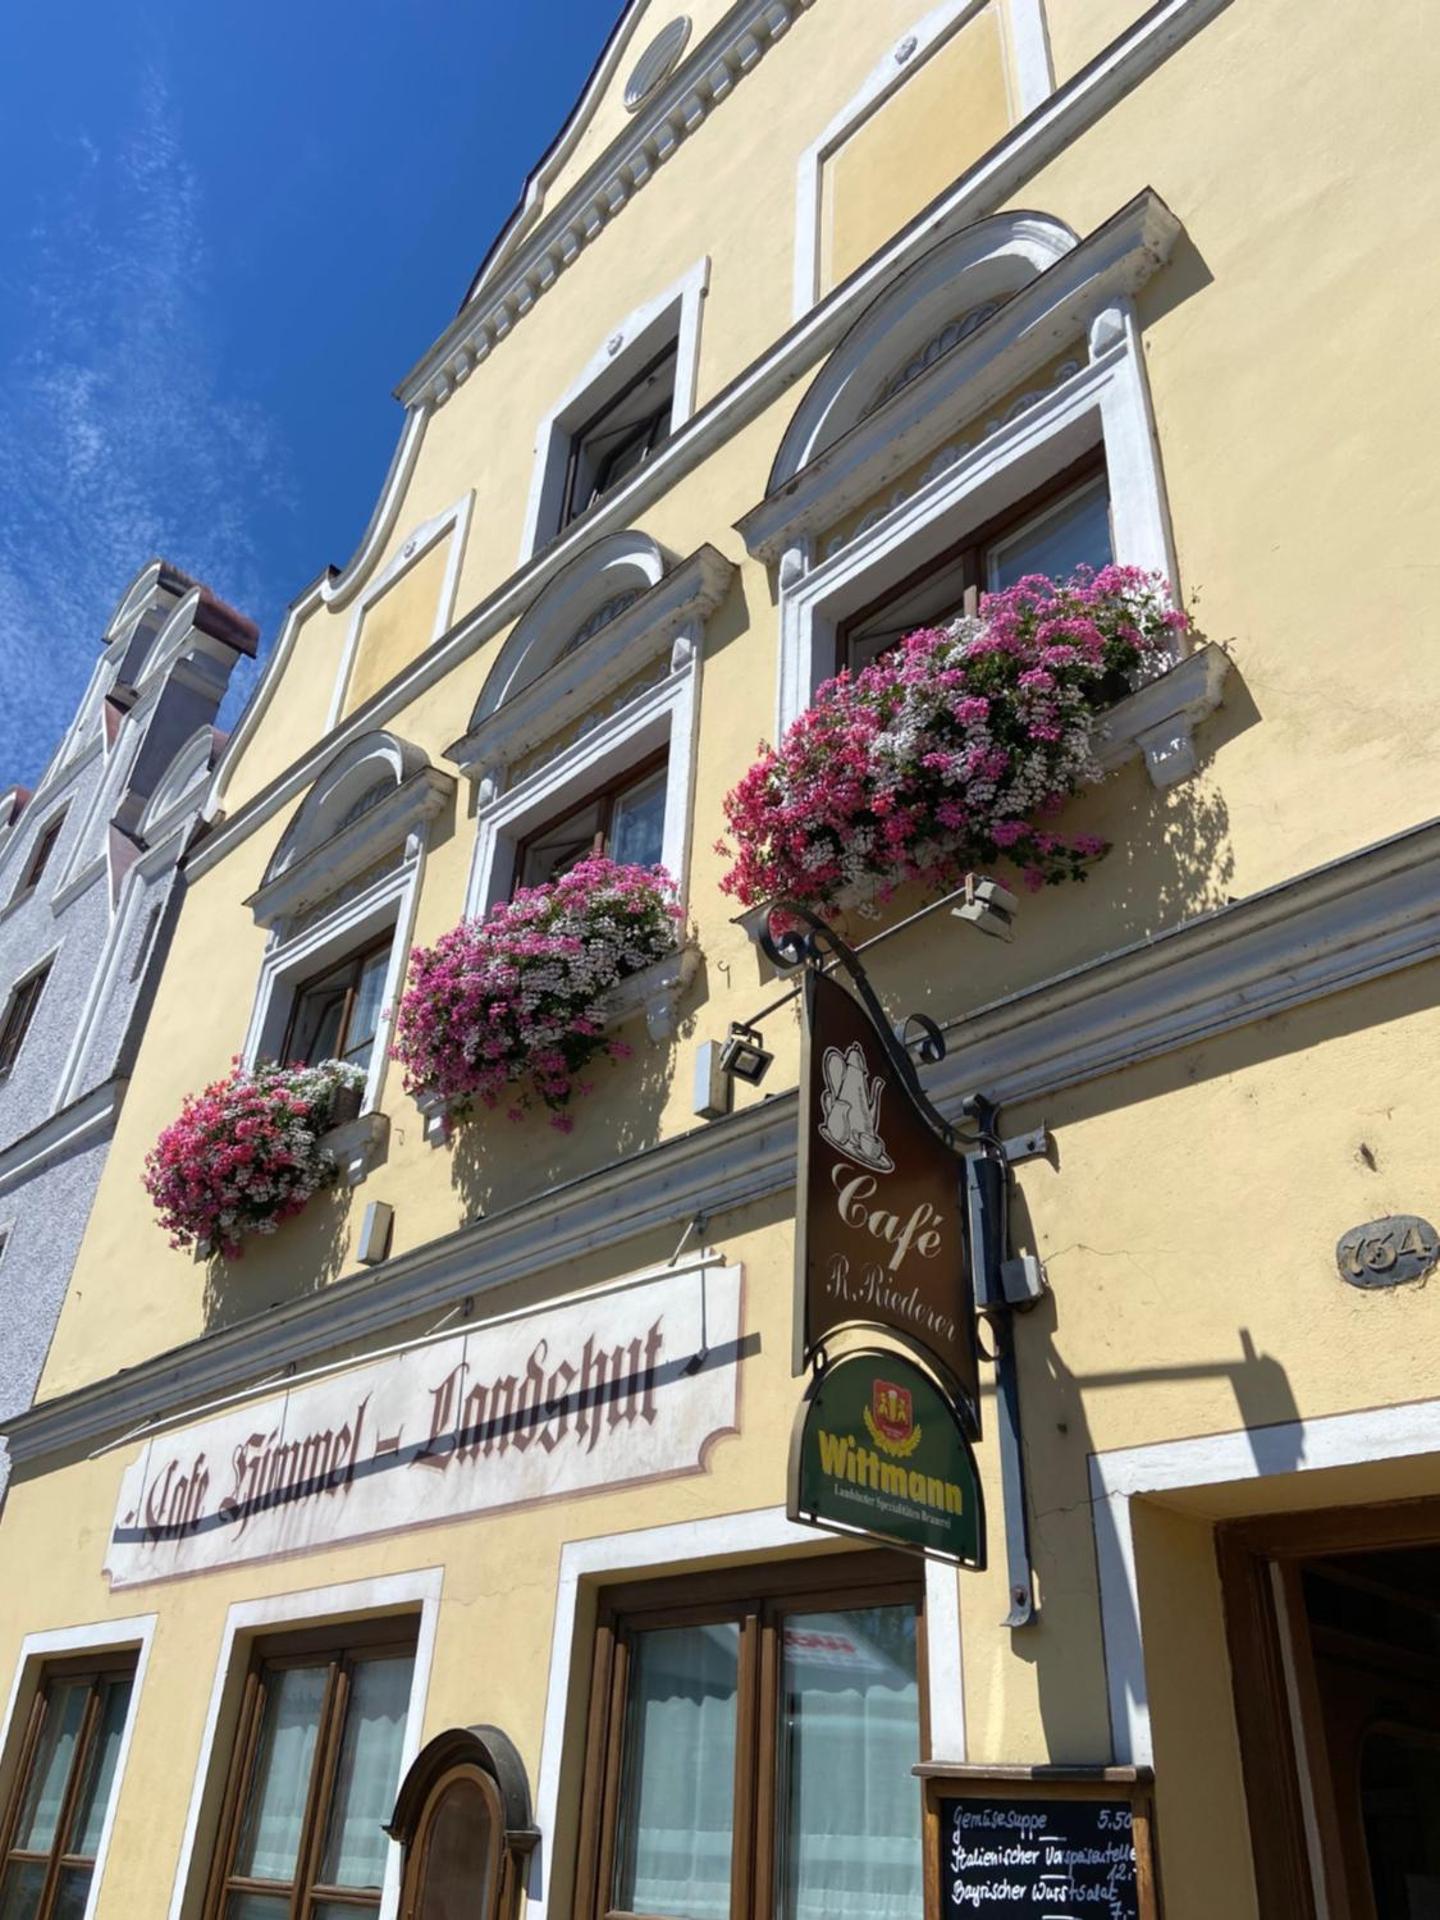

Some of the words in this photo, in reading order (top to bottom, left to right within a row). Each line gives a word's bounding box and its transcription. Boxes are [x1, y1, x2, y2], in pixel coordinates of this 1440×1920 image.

[831, 1162, 944, 1272] Café
[408, 1314, 664, 1471] Landshut
[818, 1429, 963, 1516] Wittmann
[952, 1878, 1027, 1908] Bayrischer
